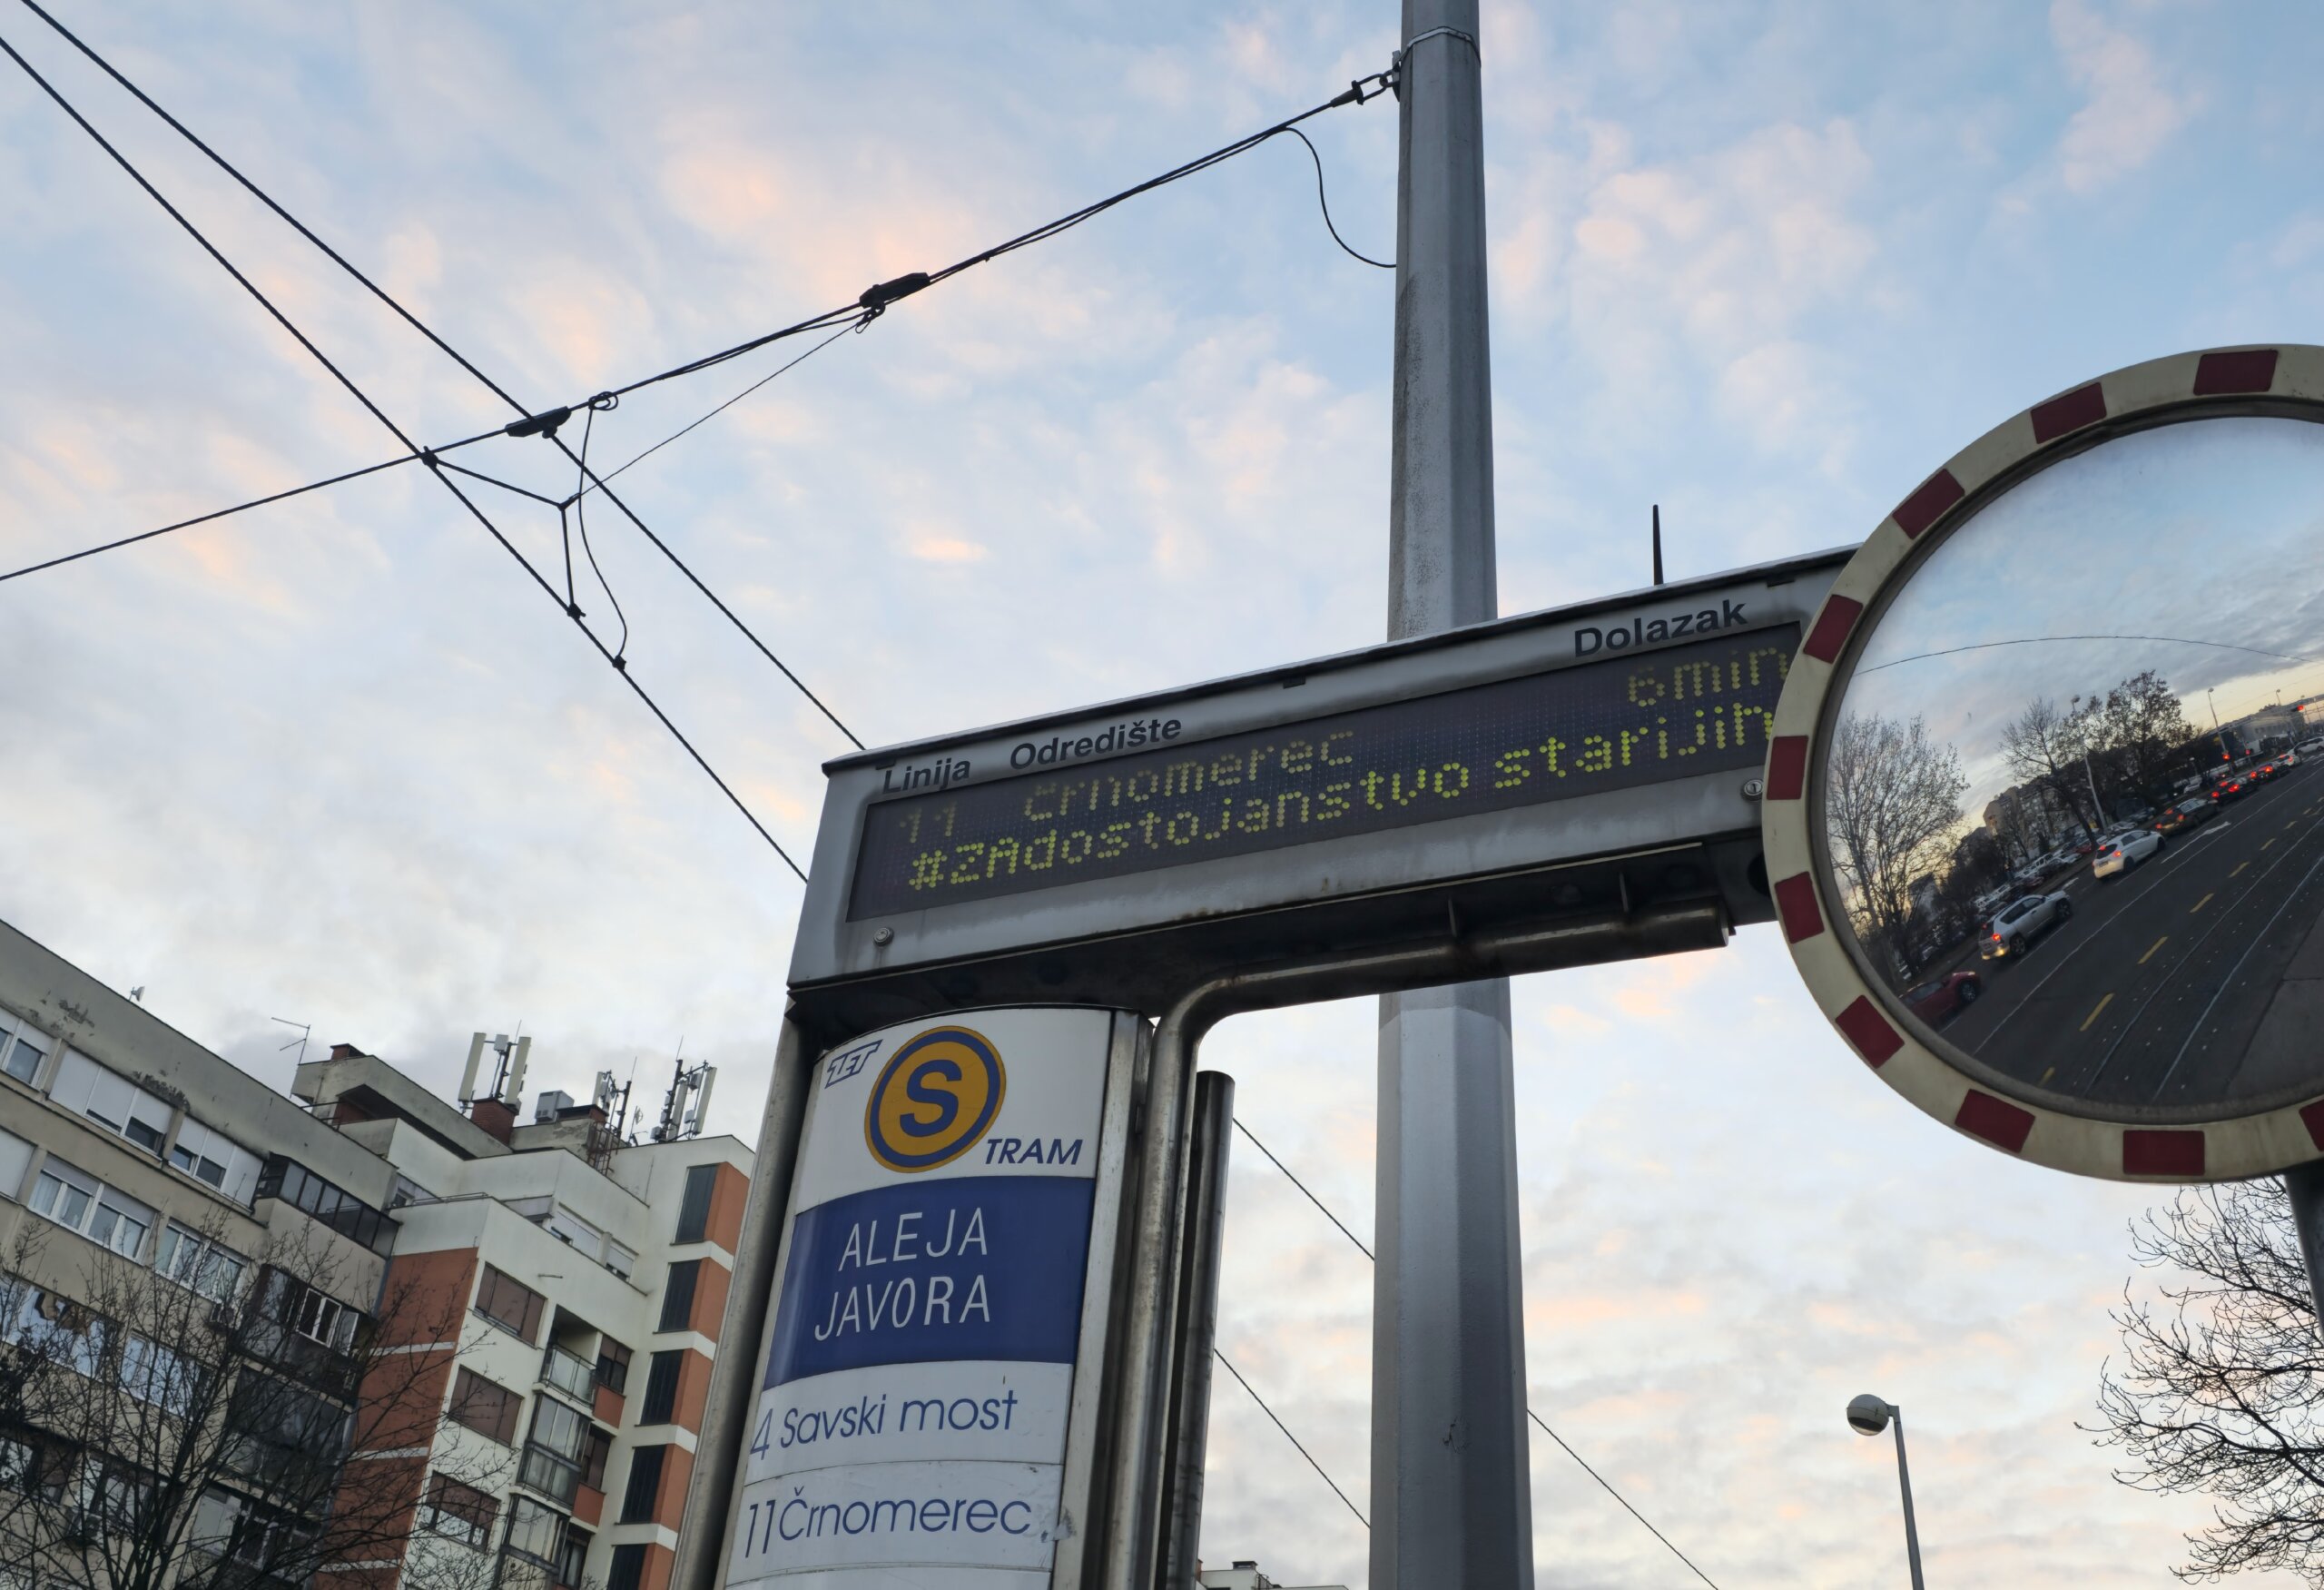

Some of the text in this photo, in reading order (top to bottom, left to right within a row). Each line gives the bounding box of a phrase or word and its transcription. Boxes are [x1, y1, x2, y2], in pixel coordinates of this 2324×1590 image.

[881, 599, 1748, 795] Linija Odredište Dolazak
[899, 800, 957, 843] 11
[824, 1039, 883, 1089] ZET
[900, 1059, 963, 1138] S
[985, 1138, 1083, 1166] TRAM
[838, 1207, 988, 1271] ALEJA
[814, 1274, 990, 1341] JAVORA
[750, 1389, 1018, 1461] 4 Savski most
[744, 1485, 1032, 1558] 11 Črnomerec
